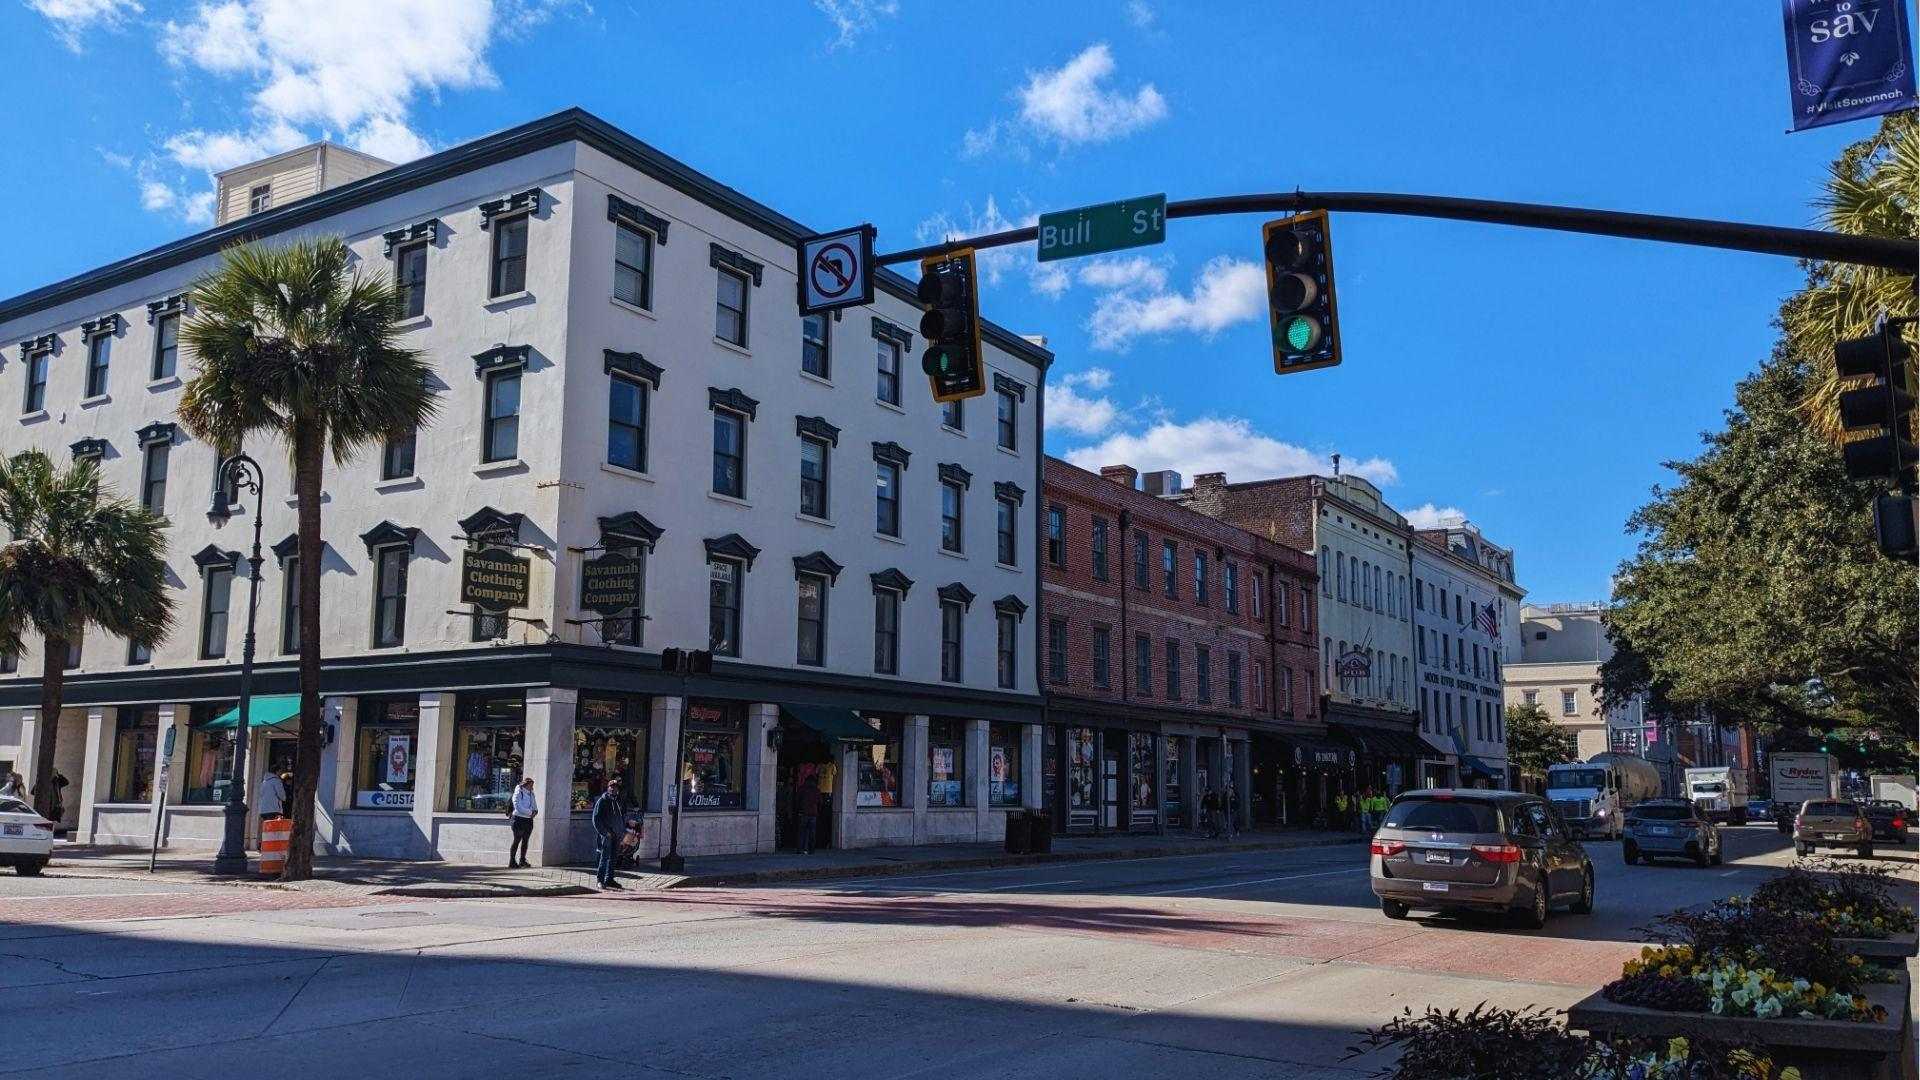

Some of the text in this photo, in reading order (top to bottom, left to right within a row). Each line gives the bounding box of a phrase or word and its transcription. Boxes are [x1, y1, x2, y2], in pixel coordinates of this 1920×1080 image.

[1836, 2, 1851, 13] to
[1810, 8, 1880, 43] sav
[1806, 89, 1903, 114] #VisitSavannah
[1042, 208, 1161, 250] Bull St
[466, 555, 527, 574] Savannah
[584, 560, 640, 577] Savannah
[470, 570, 523, 590] Clothing
[588, 577, 635, 590] Clothing
[466, 584, 525, 604] Company
[584, 592, 638, 606] Company
[1788, 767, 1820, 778] Ryder
[386, 793, 415, 805] COSTA
